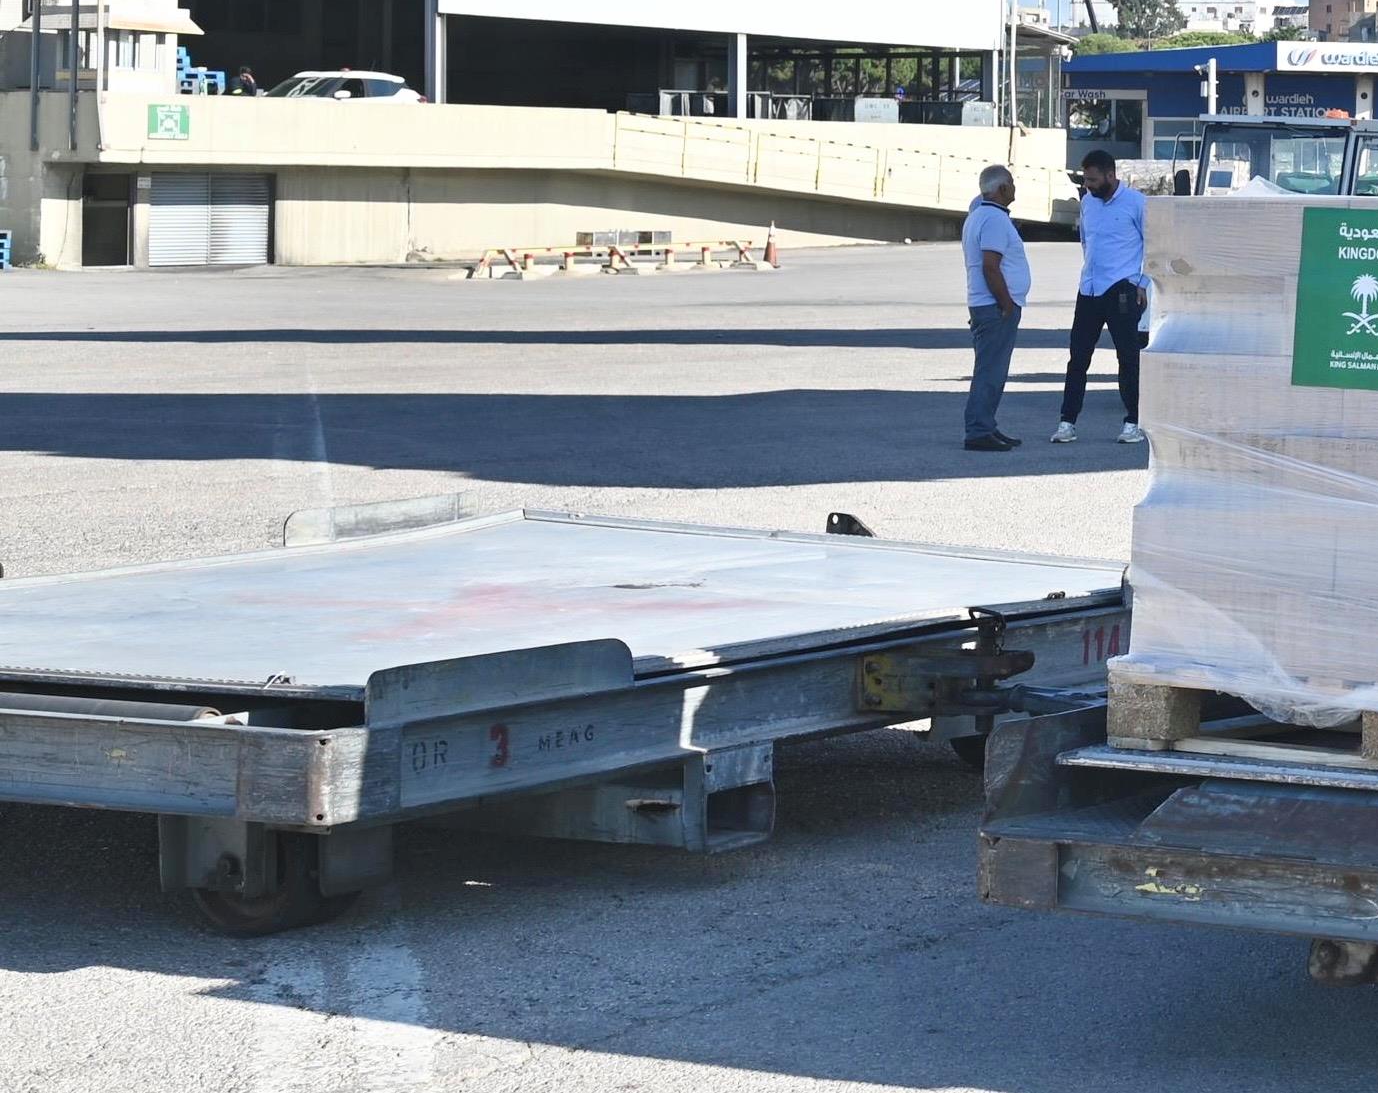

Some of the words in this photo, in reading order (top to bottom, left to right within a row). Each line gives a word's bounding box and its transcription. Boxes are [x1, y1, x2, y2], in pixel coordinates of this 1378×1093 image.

[1078, 90, 1106, 99] Wash
[1265, 94, 1314, 105] wardieh
[1329, 361, 1347, 369] KING
[1347, 361, 1377, 371] SALMAN
[489, 724, 509, 767] 3
[538, 725, 595, 752] MEAG
